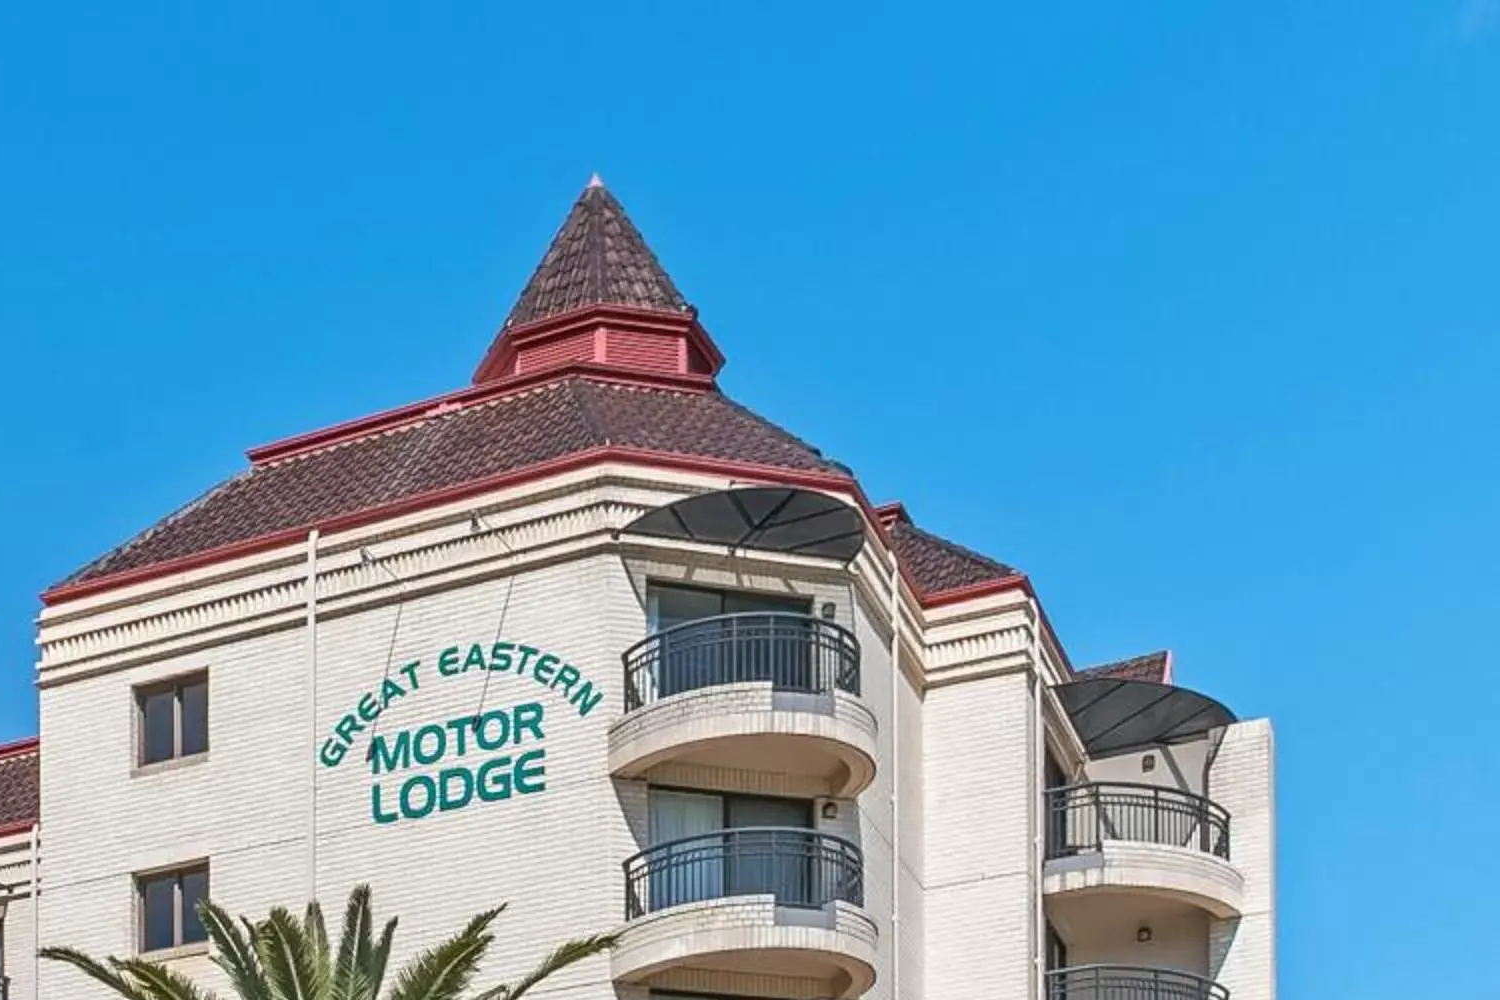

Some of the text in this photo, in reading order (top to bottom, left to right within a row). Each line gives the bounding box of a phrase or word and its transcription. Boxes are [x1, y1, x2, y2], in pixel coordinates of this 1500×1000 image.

[319, 641, 603, 768] GREAT EASTERN
[371, 702, 545, 774] MOTOR
[371, 749, 546, 824] LODGE
